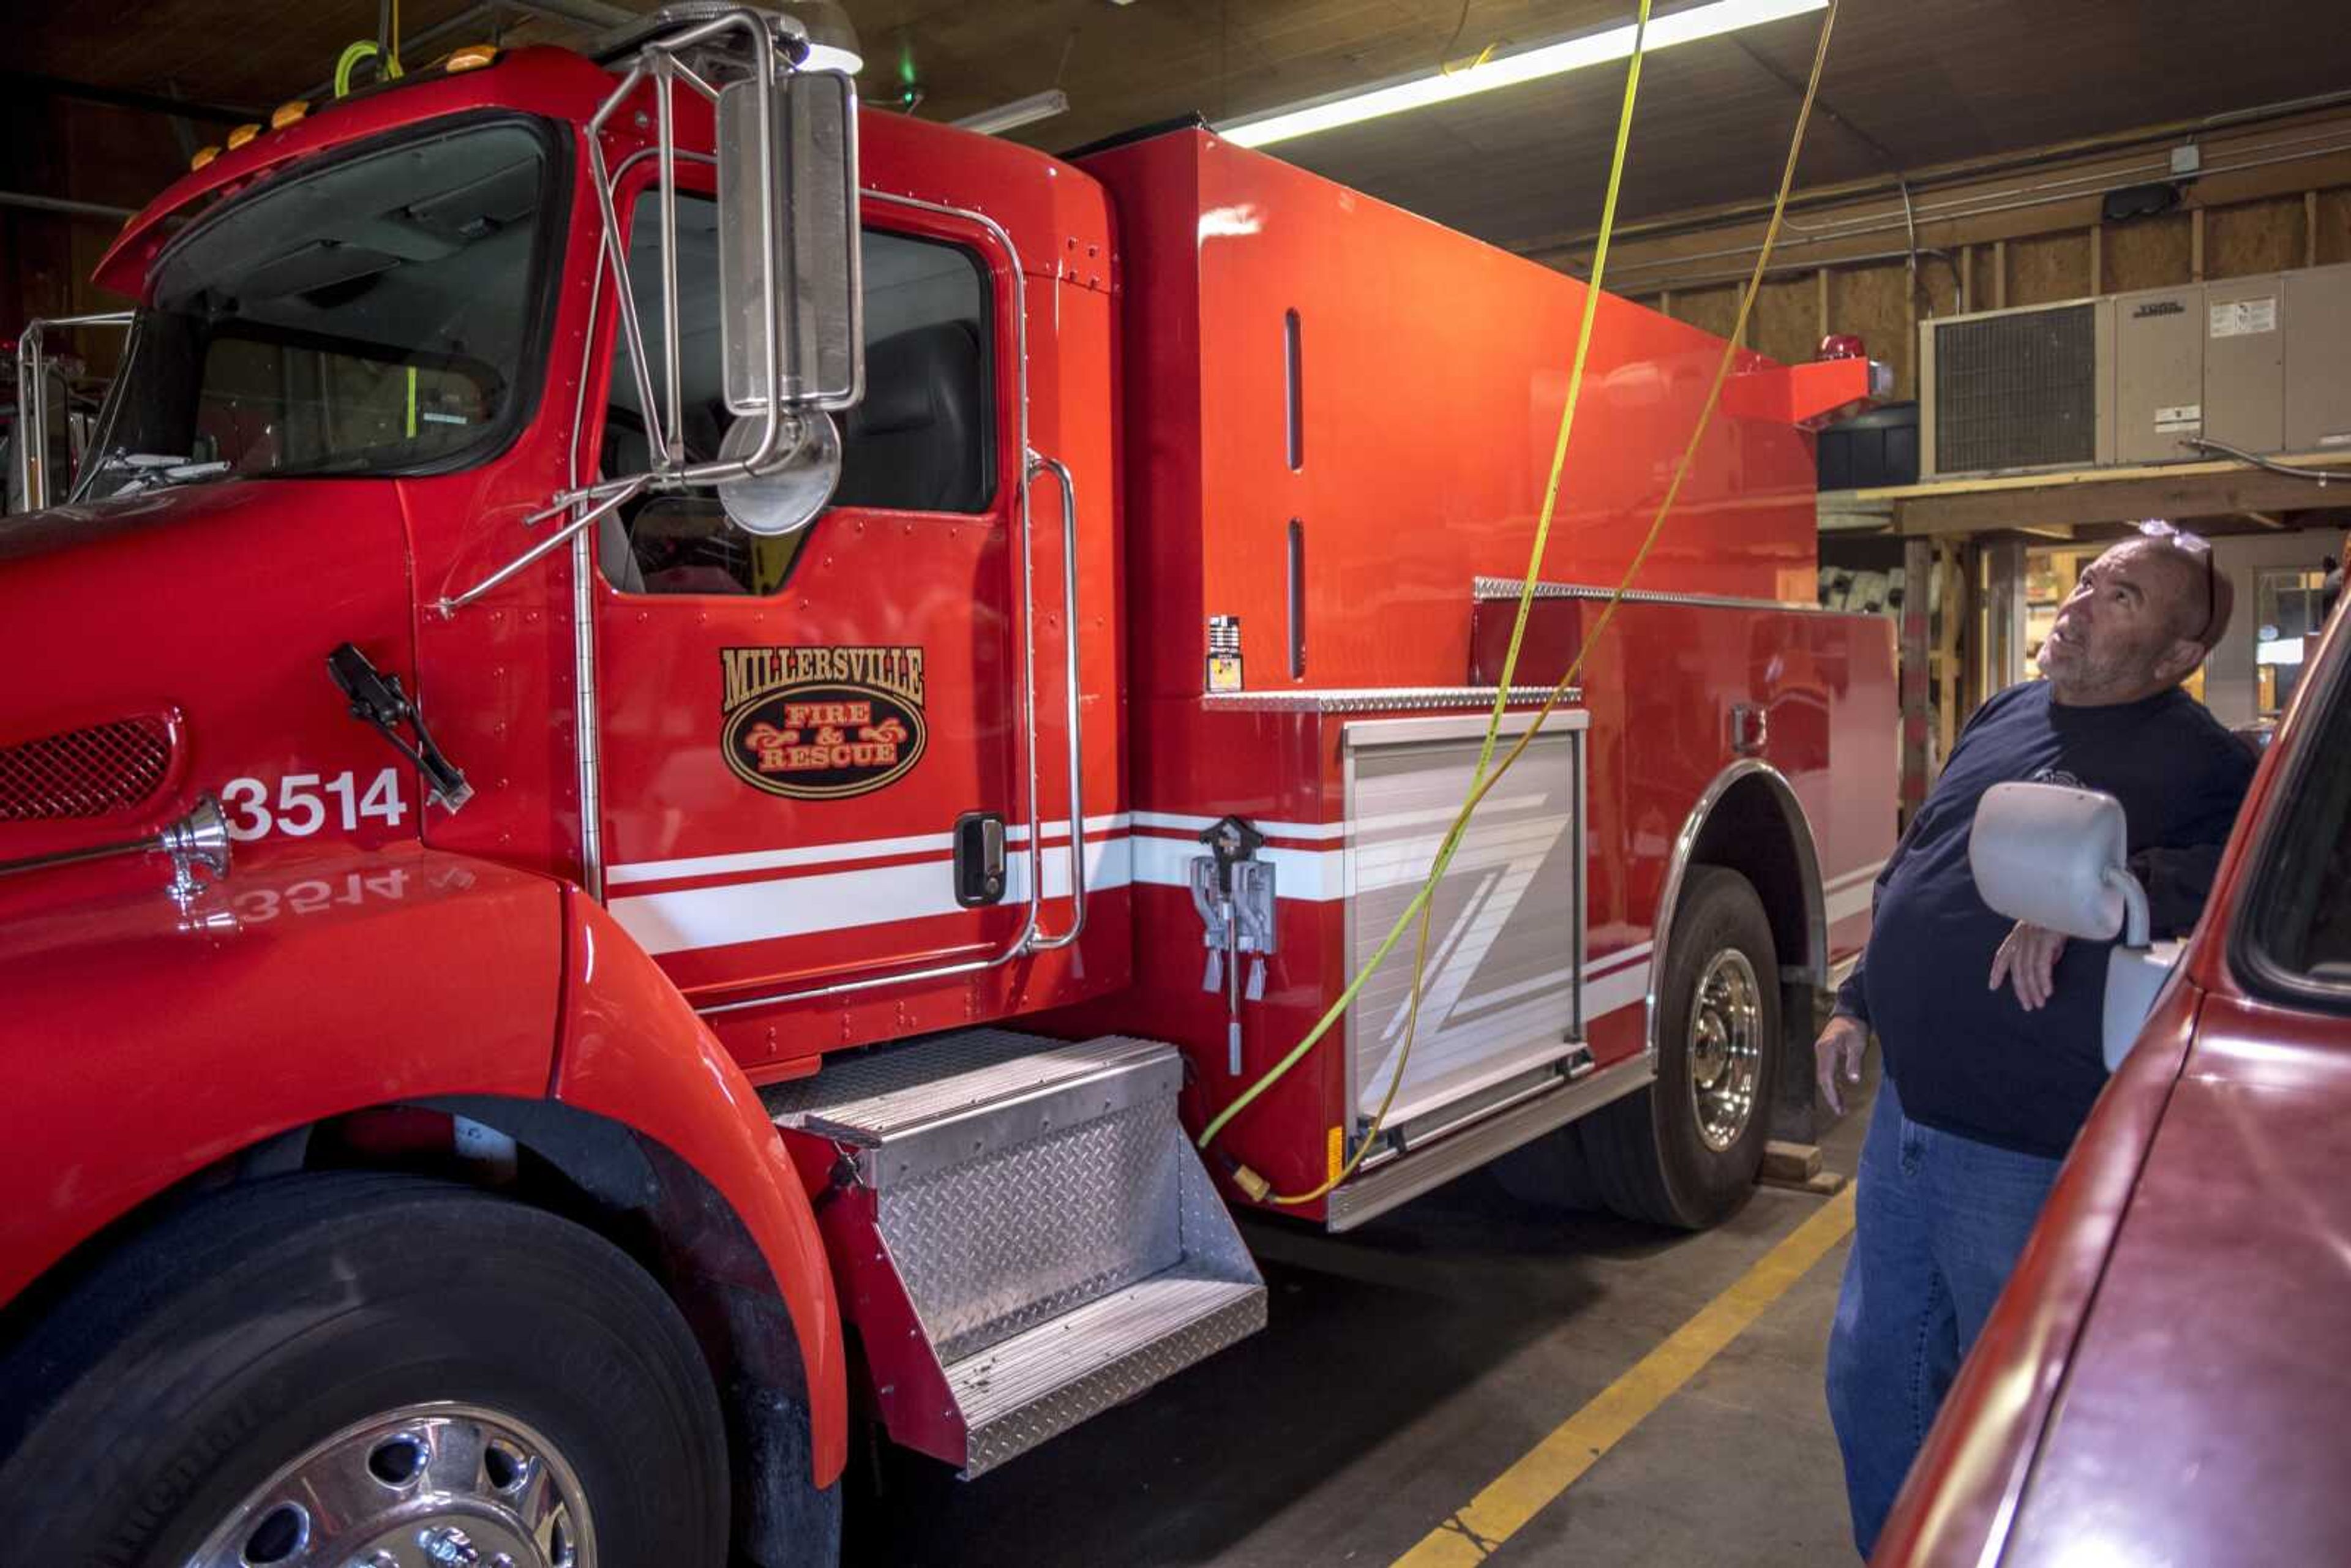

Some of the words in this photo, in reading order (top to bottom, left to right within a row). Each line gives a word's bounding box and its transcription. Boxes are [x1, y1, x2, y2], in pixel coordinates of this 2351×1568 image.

[722, 647, 923, 711] MILLERSVILLE
[786, 703, 870, 727] FIRE
[817, 726, 844, 745] &
[760, 743, 896, 770] RESCUE
[222, 767, 407, 842] 3514
